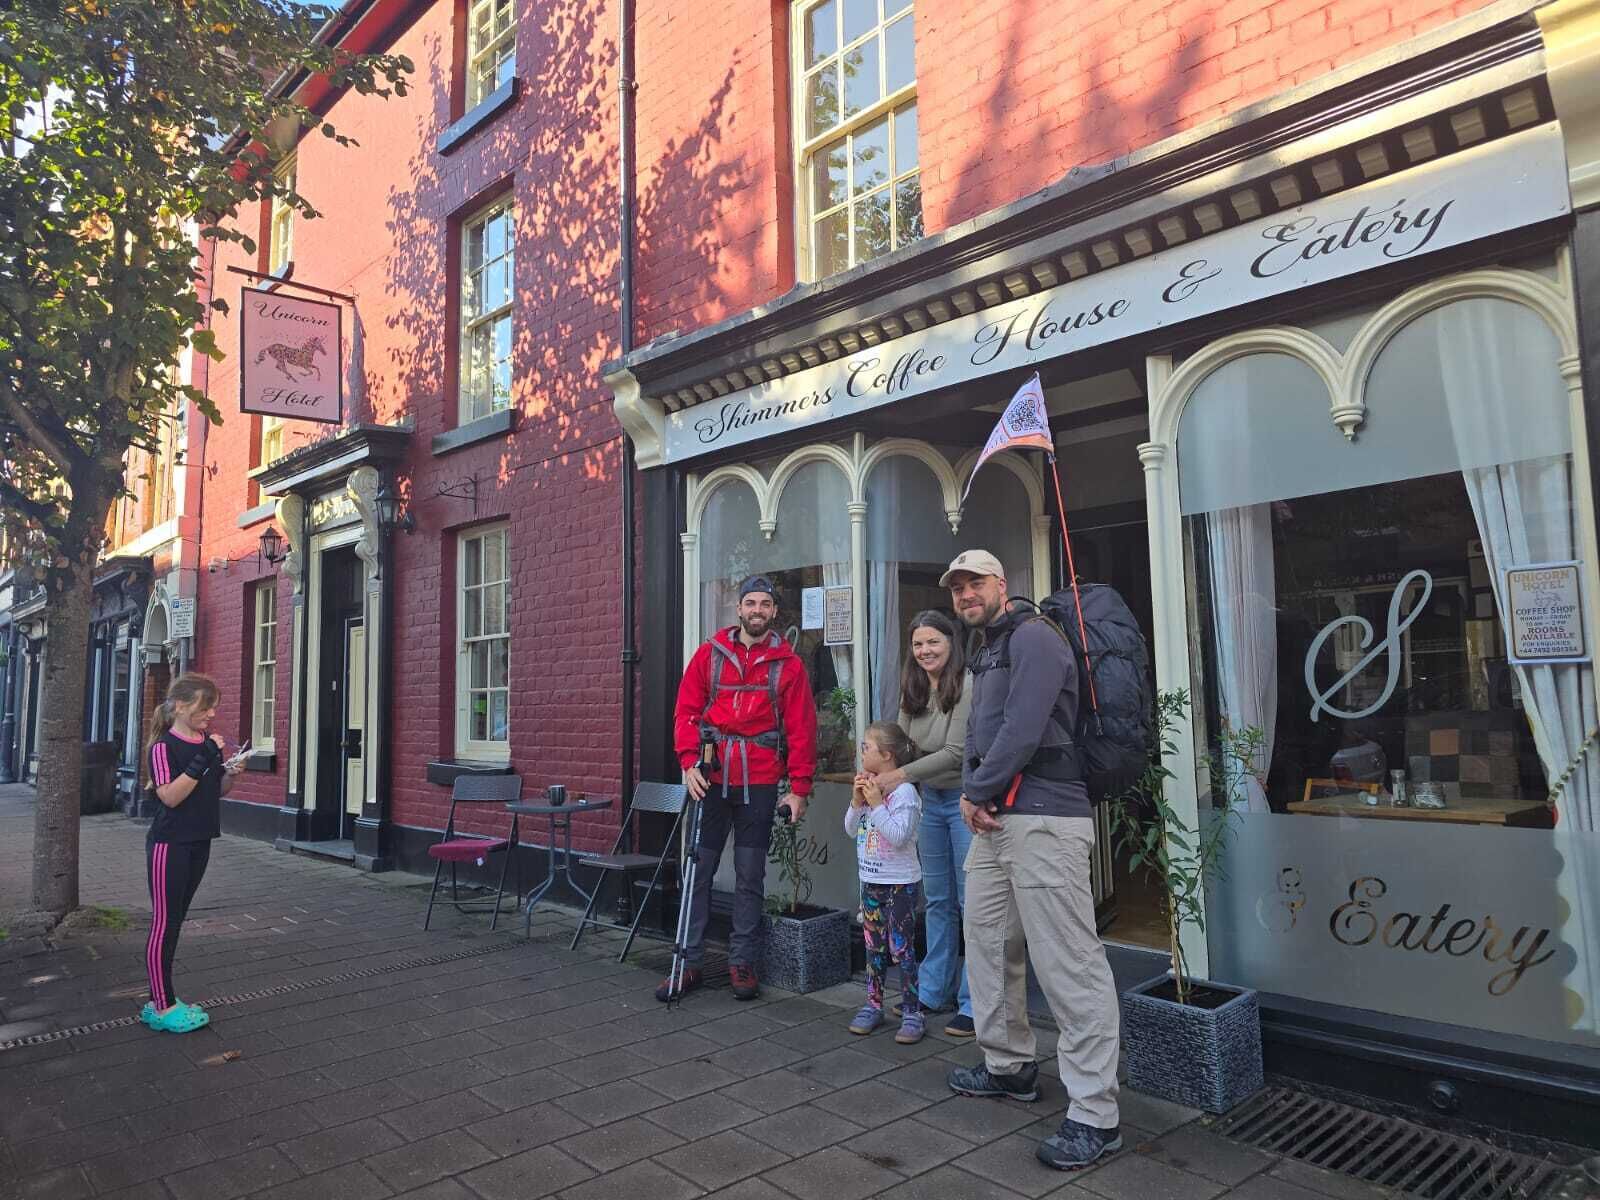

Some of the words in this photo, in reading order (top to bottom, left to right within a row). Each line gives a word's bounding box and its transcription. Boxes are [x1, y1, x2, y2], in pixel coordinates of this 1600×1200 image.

[253, 300, 330, 327] Unicorn
[694, 385, 839, 444] Shimmers
[846, 348, 947, 398] Coffee
[970, 295, 1131, 367] House
[1161, 258, 1223, 304] &
[1250, 198, 1456, 279] Eatery
[261, 387, 326, 408] Hotel
[1513, 570, 1569, 583] UNICORN
[1522, 580, 1565, 591] HOTEL
[1515, 607, 1549, 616] COFFEE
[1550, 605, 1576, 615] SHOP
[1521, 632, 1576, 641] AVAILABLE
[1528, 626, 1565, 634] ROOMS
[1304, 568, 1433, 723] S
[1329, 876, 1556, 997] Eatery
